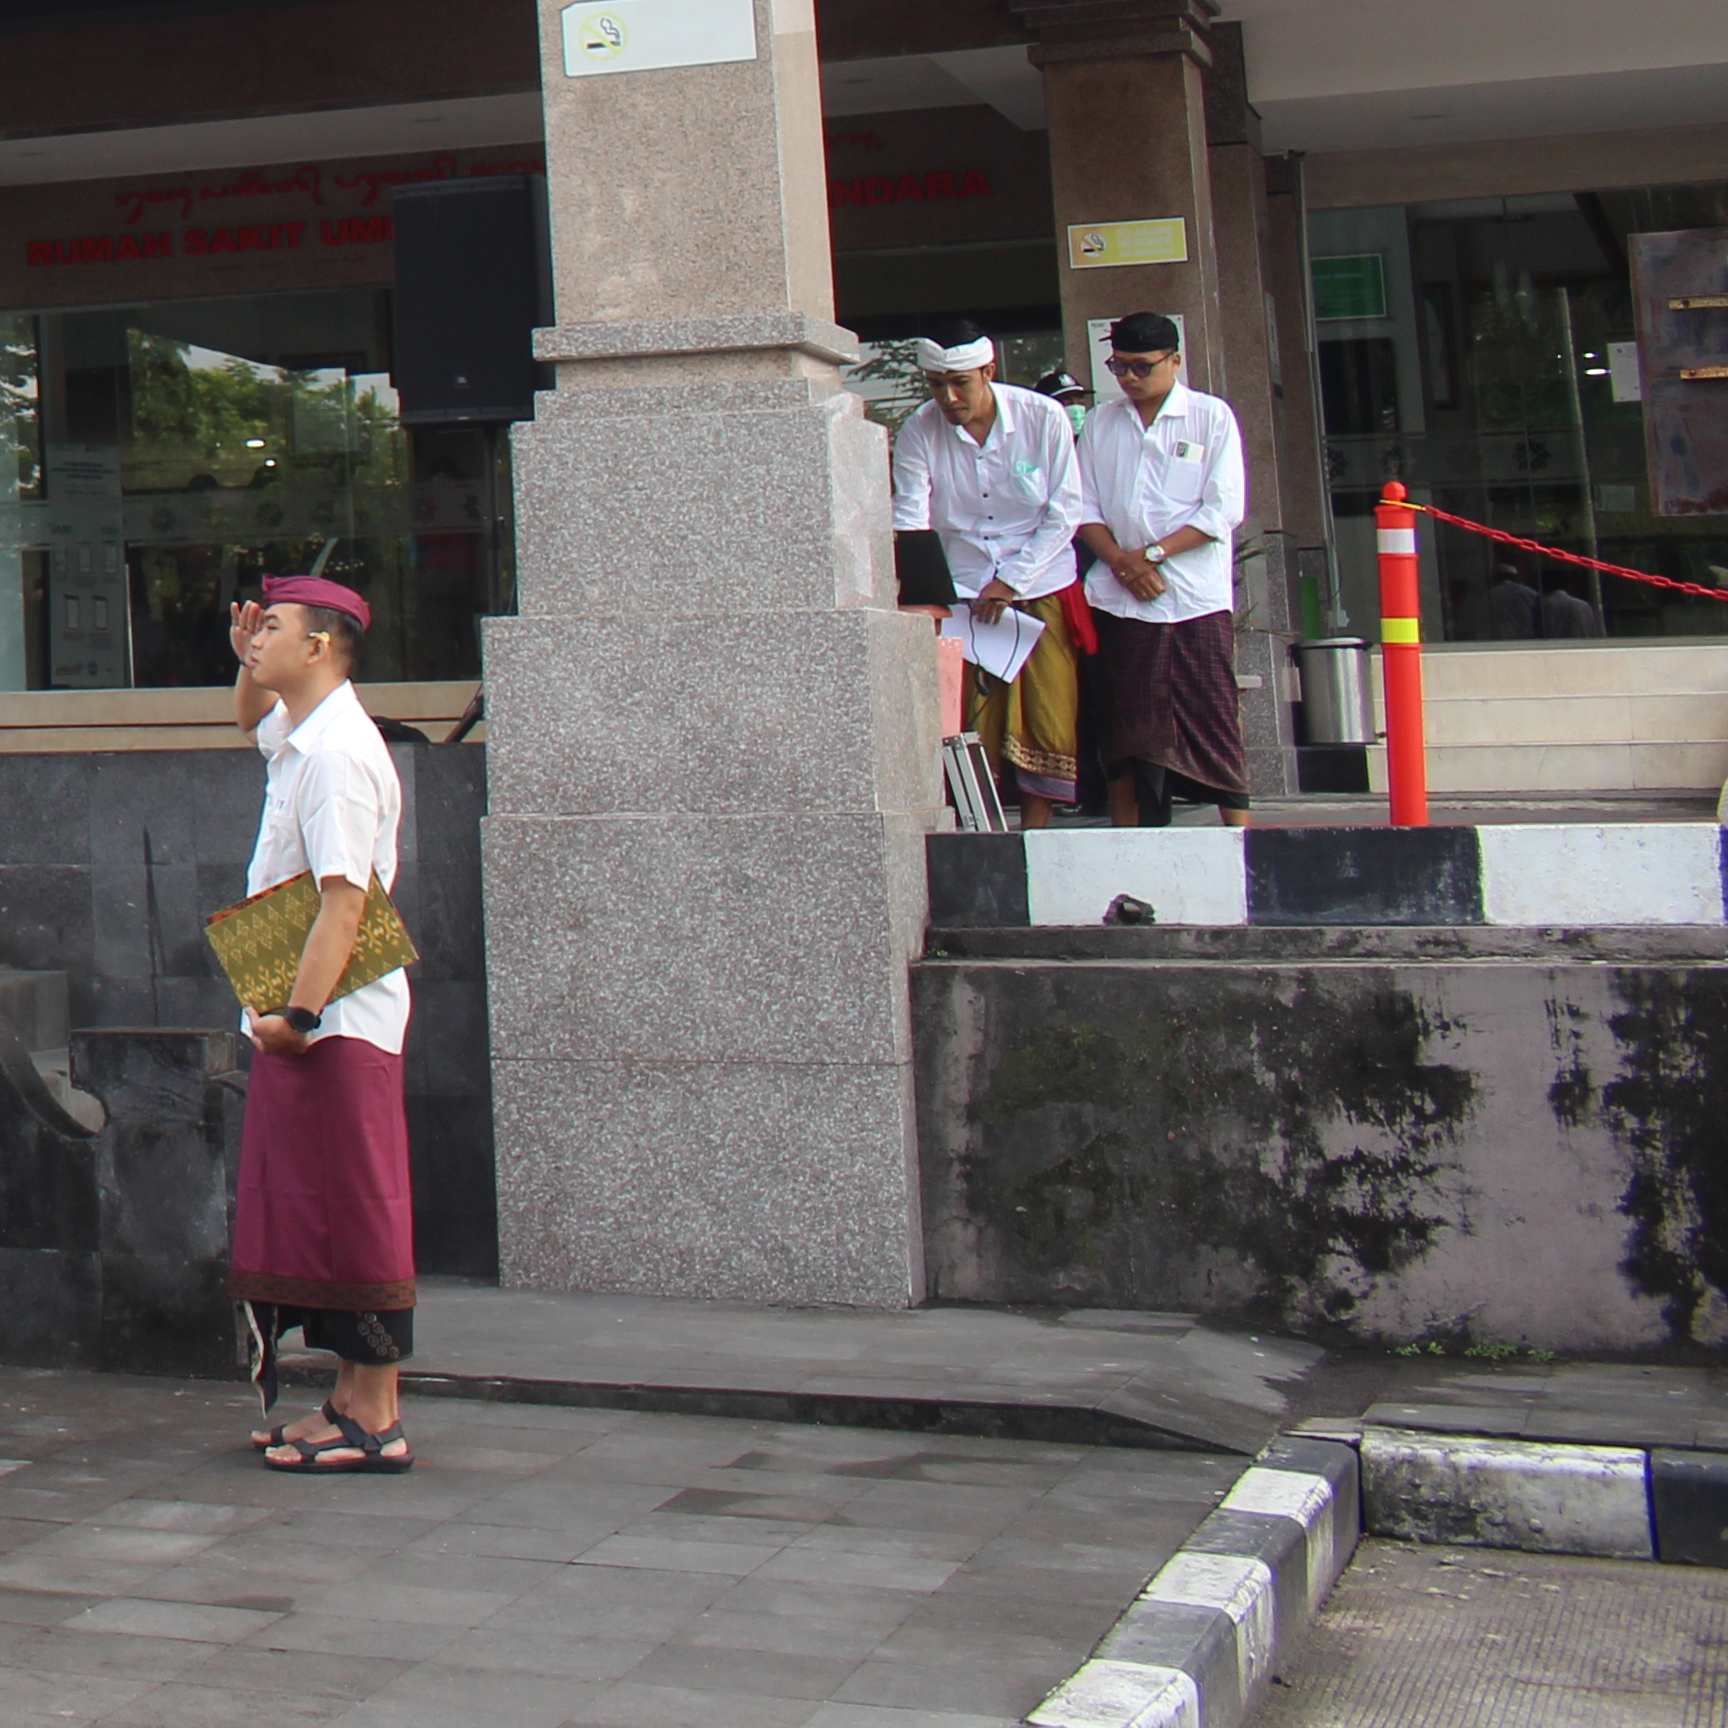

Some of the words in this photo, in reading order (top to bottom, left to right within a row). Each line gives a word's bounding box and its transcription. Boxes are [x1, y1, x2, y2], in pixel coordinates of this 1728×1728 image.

[832, 169, 993, 207] NDARA
[27, 231, 171, 268] RUMAH
[184, 221, 307, 257] SAKIT
